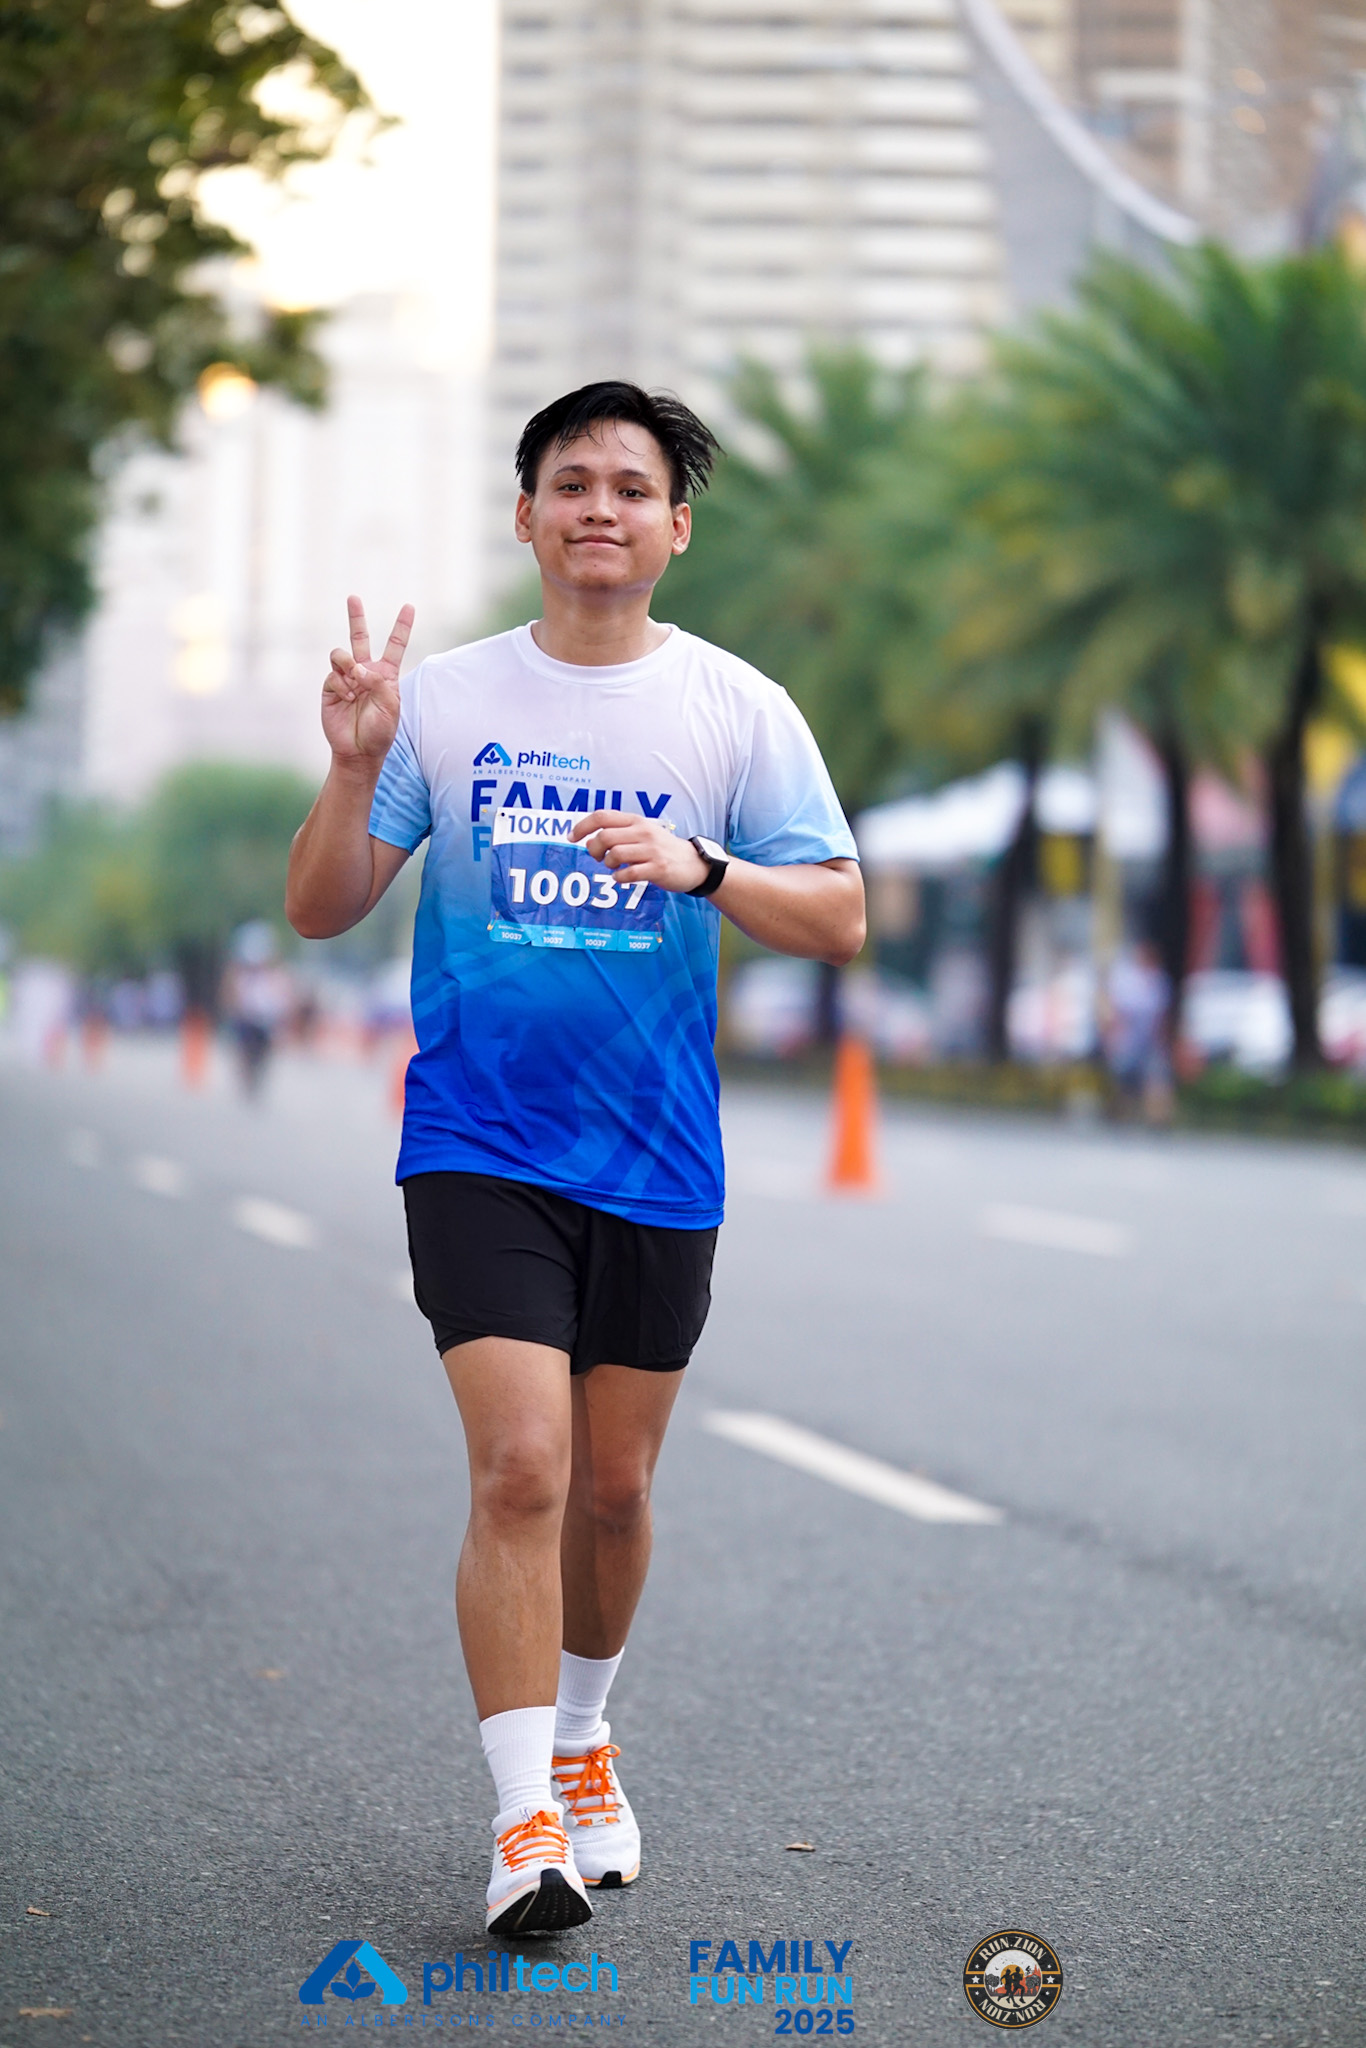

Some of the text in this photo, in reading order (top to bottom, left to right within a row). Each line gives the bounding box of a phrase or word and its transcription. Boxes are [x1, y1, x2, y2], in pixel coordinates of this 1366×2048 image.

[517, 750, 591, 771] philtech
[487, 769, 544, 780] ALBERTSONS
[548, 774, 592, 784] COMPANY
[509, 867, 650, 911] 10037
[501, 931, 523, 940] 10037
[542, 936, 564, 945] 10037
[584, 938, 607, 947] 10037
[628, 941, 651, 949] 10037
